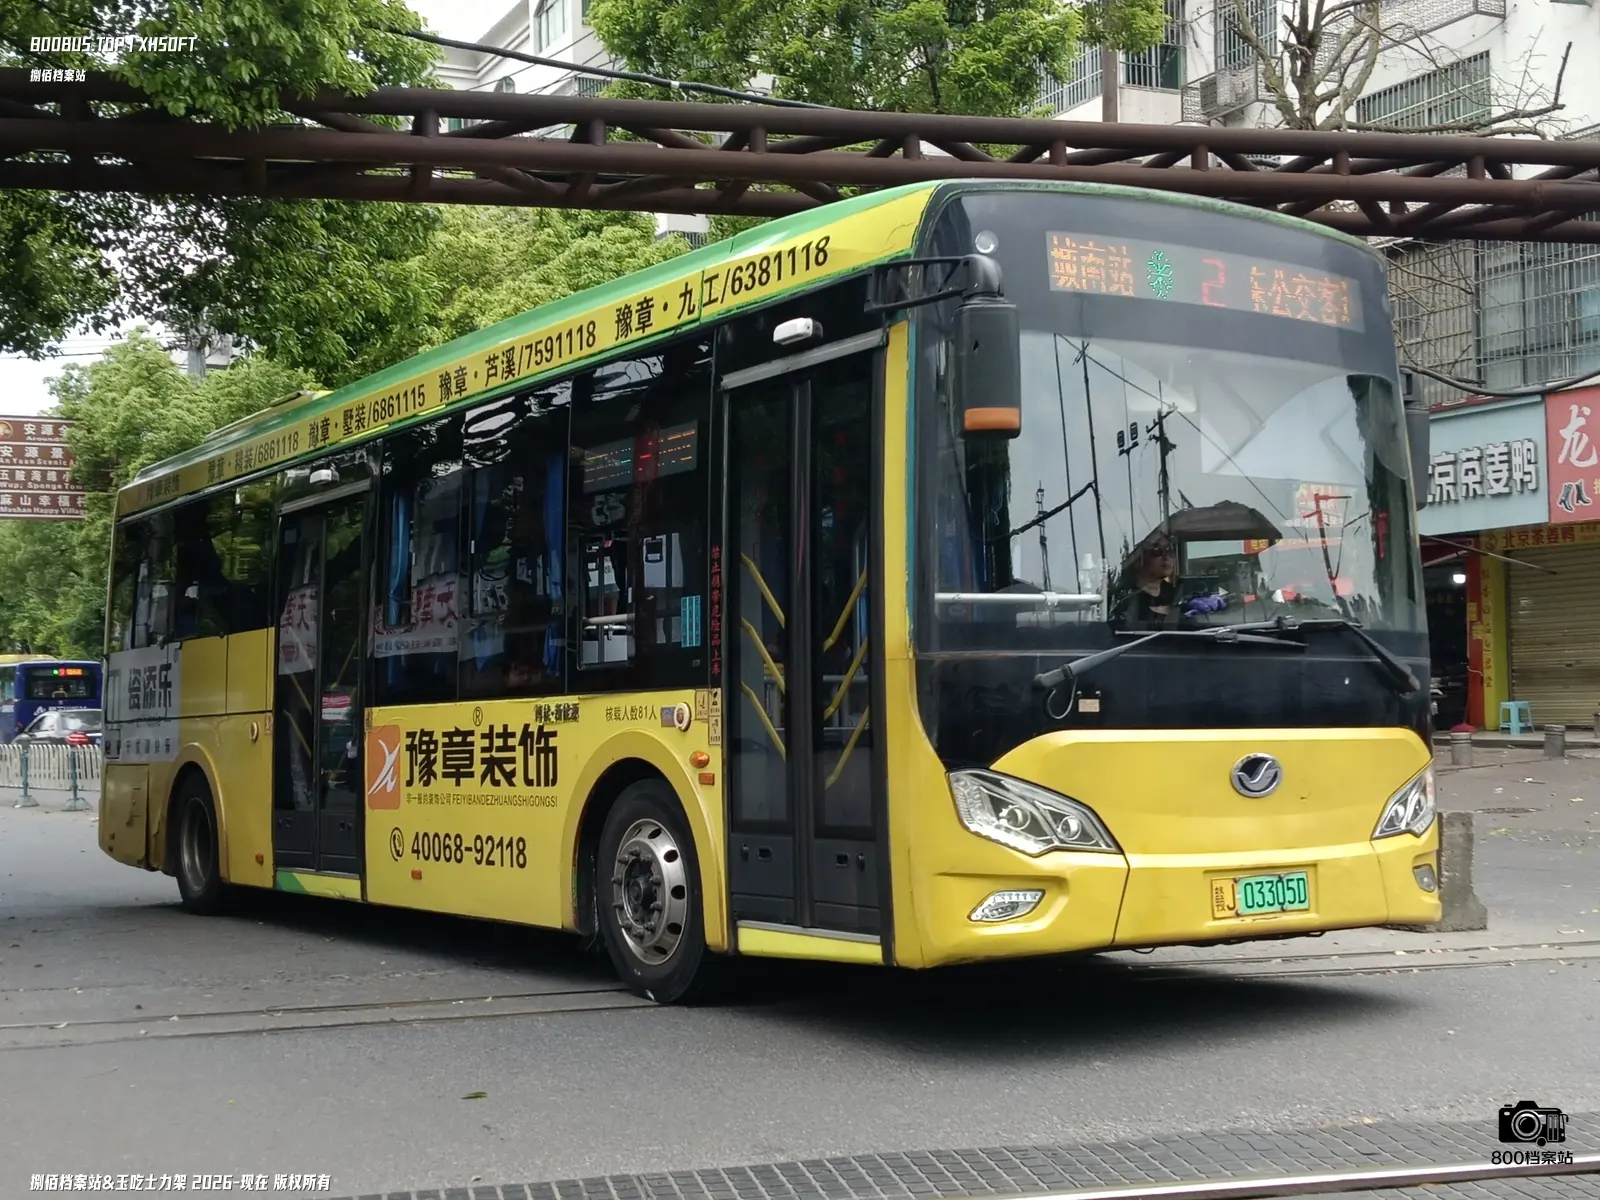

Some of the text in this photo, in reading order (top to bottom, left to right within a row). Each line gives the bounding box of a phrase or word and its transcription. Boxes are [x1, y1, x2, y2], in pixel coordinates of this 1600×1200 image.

[1202, 257, 1227, 307] 2
[37, 458, 67, 466] Scenic
[1427, 438, 1537, 504] 京茶姜鸭
[61, 507, 87, 516] Villag
[606, 705, 657, 722] 核载人数81人
[405, 724, 558, 788] 豫章装饰
[411, 832, 528, 869] 40068-92118
